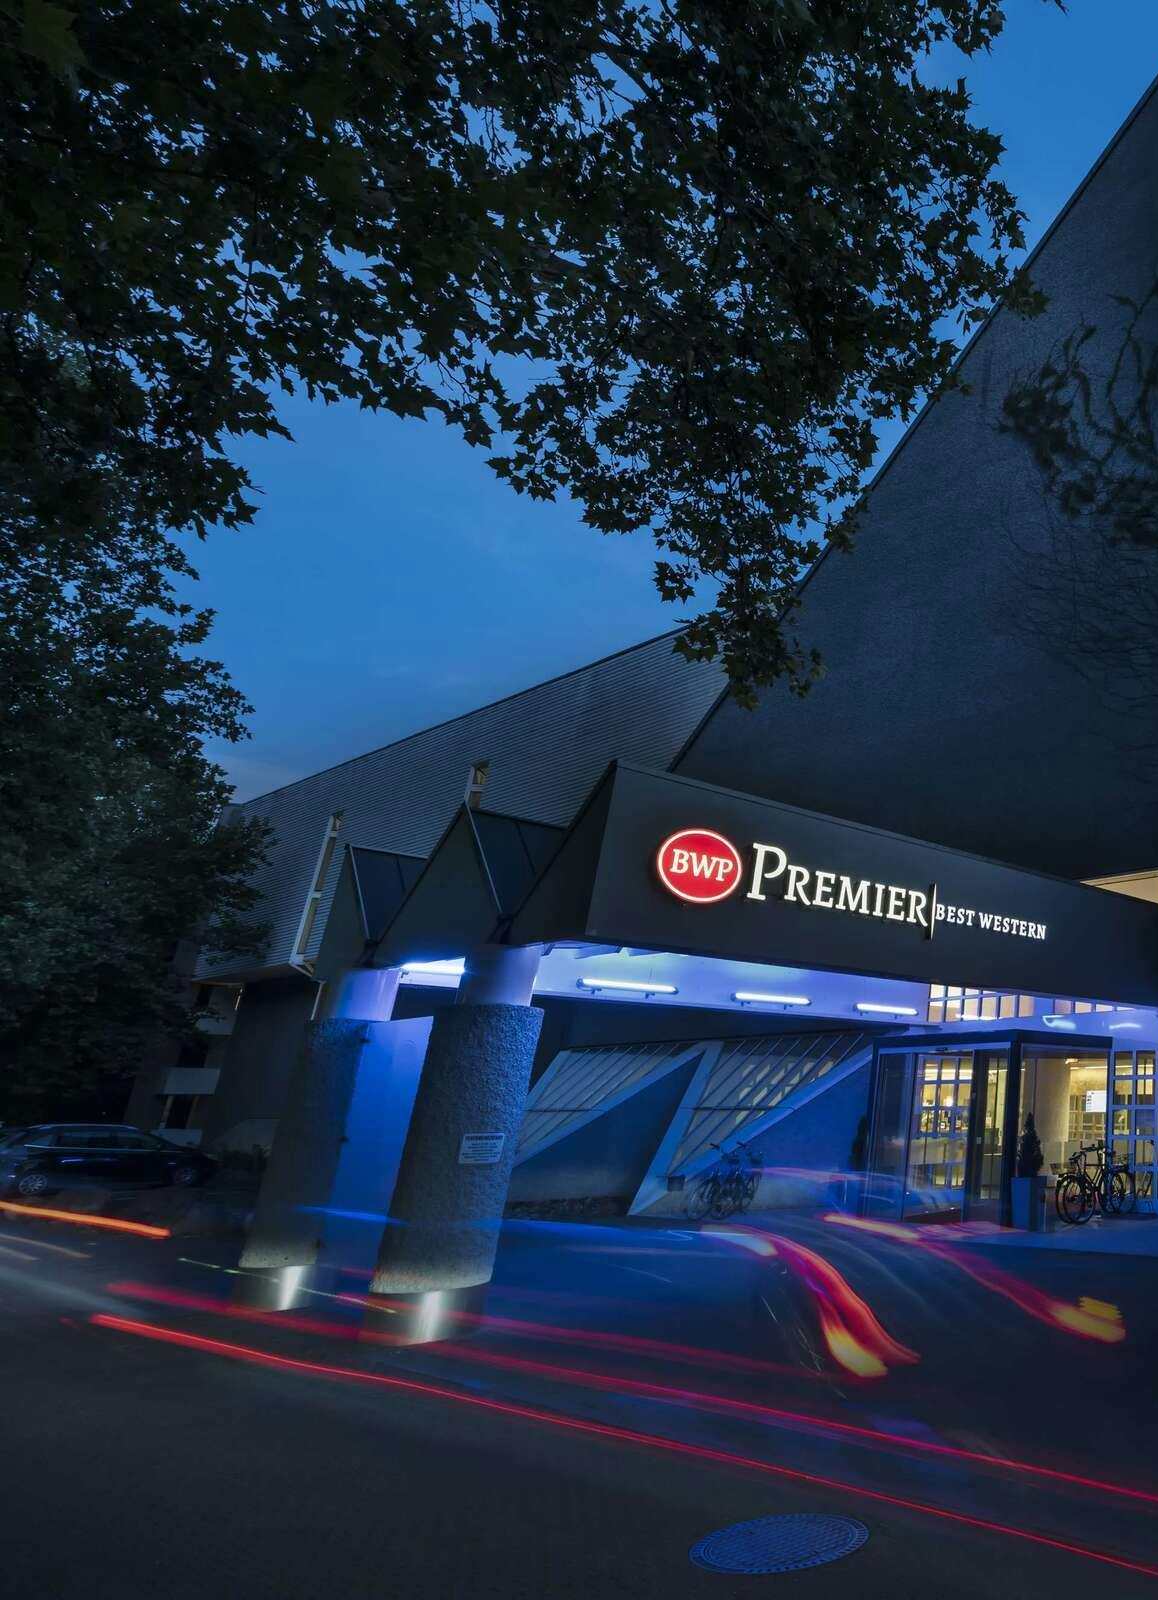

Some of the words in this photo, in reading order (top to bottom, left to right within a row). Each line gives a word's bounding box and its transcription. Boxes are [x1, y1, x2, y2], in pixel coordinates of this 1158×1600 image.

[670, 848, 734, 882] BWP
[746, 842, 929, 927] PREMIER
[935, 903, 976, 926] BEST
[979, 912, 1047, 940] WESTERN
